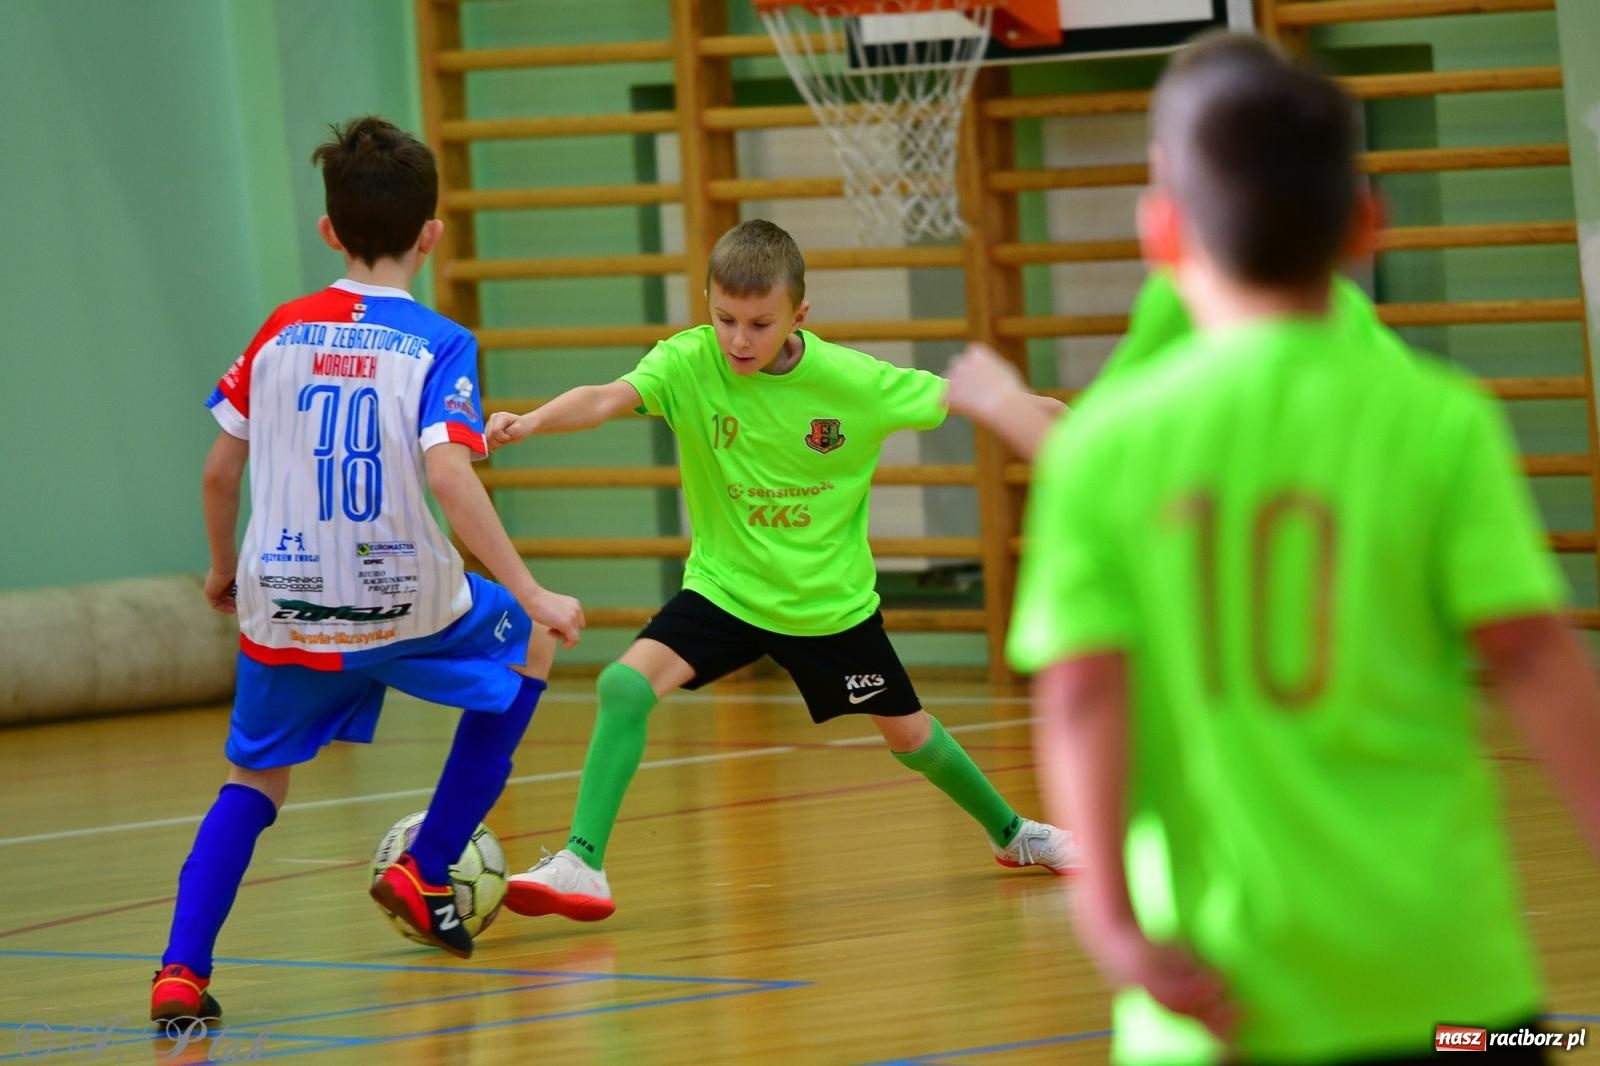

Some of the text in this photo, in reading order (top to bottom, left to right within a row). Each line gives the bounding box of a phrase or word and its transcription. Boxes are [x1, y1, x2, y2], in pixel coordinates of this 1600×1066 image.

[712, 414, 738, 450] 19
[748, 504, 811, 528] KKS
[1156, 484, 1339, 715] 10
[844, 673, 885, 690] KKS
